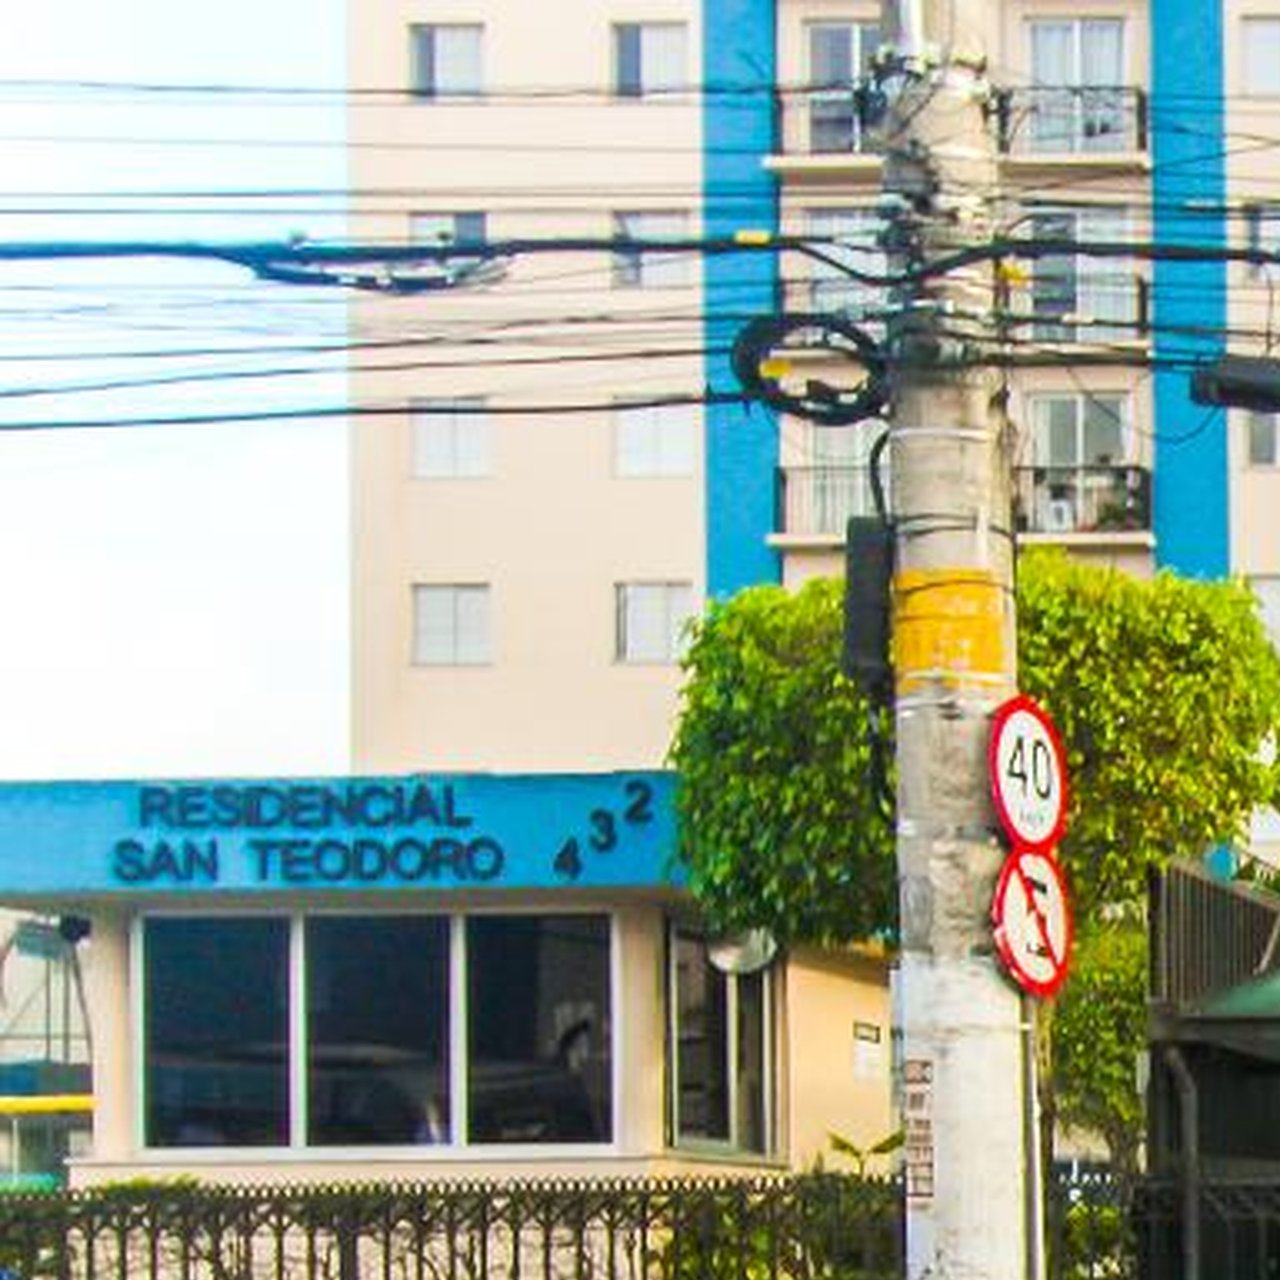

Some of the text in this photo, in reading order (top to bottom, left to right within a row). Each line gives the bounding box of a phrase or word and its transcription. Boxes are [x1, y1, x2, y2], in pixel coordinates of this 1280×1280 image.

[1007, 735, 1051, 799] 40
[139, 785, 473, 828] RESIDENCIAL
[552, 779, 654, 881] 432
[113, 836, 504, 881] SAN TEODORO
